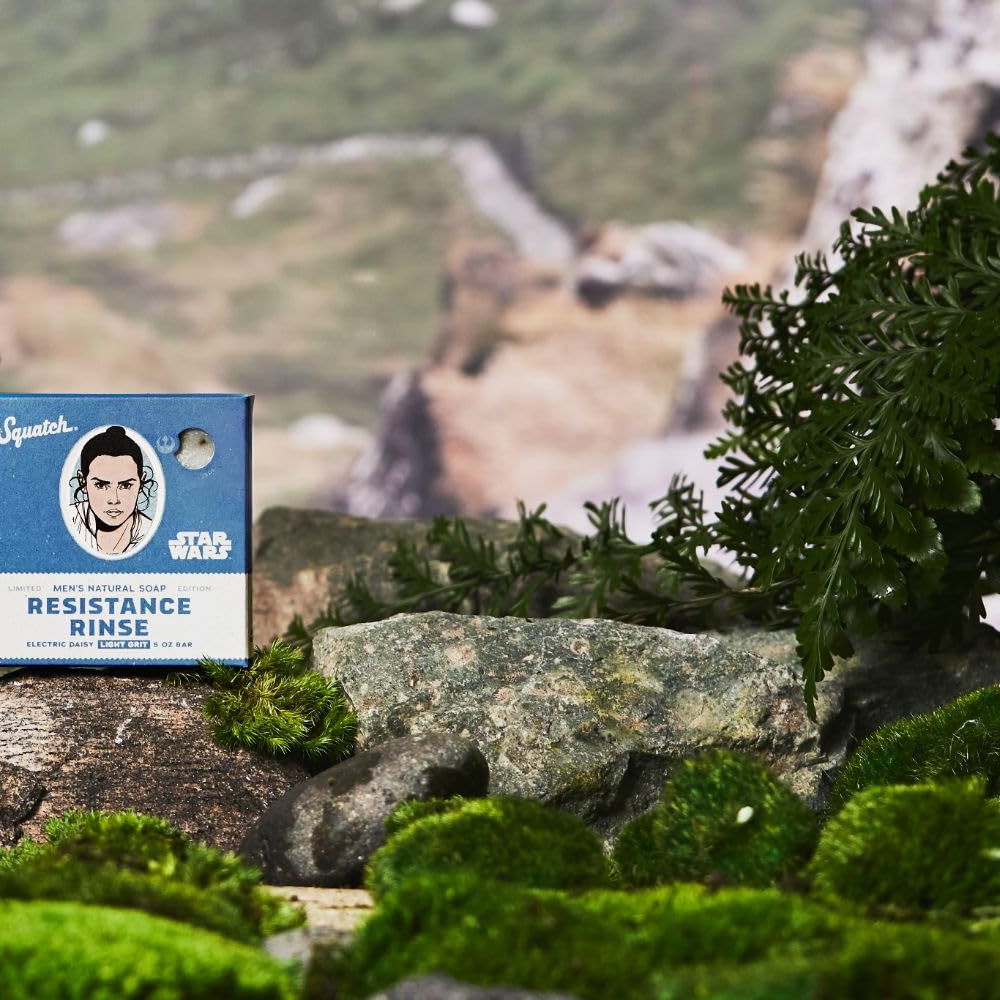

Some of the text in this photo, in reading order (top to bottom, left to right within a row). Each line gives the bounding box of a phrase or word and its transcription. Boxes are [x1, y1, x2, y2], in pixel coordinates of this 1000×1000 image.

[168, 531, 232, 546] STAR
[168, 545, 232, 560] WARS
[53, 584, 84, 592] MEN'S
[88, 584, 135, 592] NATURAL
[139, 584, 167, 592] SOAP
[27, 597, 192, 615] RESISTANCE
[70, 619, 149, 636] RINSE
[100, 640, 126, 649] LIGHT
[127, 640, 149, 649] GRIT
